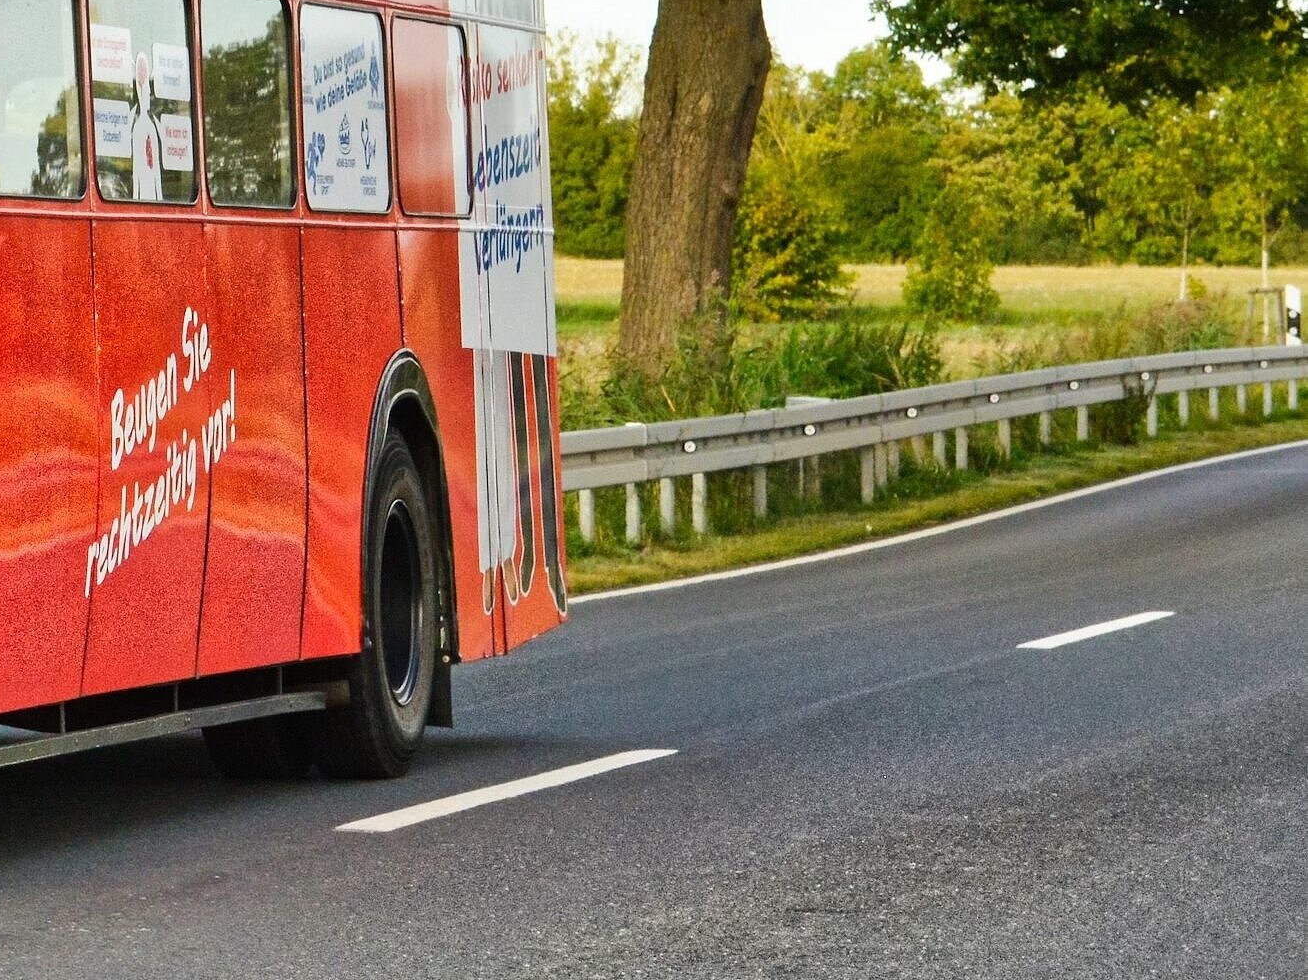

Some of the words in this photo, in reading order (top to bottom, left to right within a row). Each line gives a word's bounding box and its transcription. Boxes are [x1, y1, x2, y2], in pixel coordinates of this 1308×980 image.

[84, 427, 197, 599] rechtzeitig
[201, 368, 236, 474] vor!
[110, 352, 178, 472] Beugen
[182, 305, 212, 392] Sie
